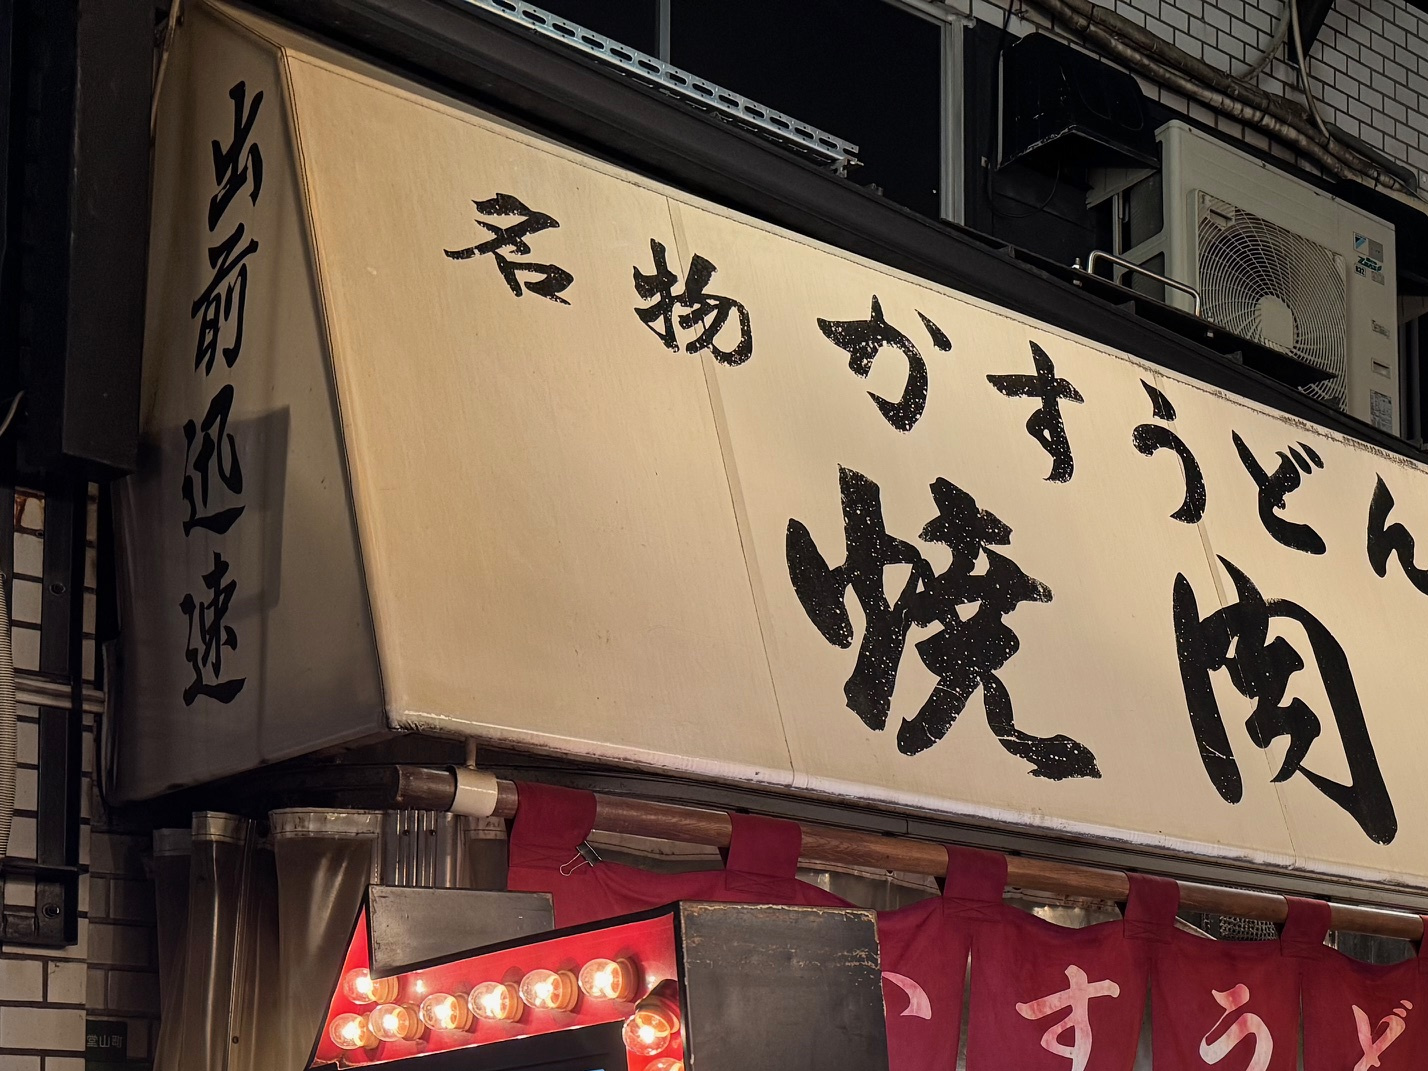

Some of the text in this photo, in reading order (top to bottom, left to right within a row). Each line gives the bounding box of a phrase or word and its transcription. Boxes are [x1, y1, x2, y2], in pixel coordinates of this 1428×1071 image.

[180, 81, 264, 706] 出前迅速
[86, 1034, 123, 1048] 堂山町
